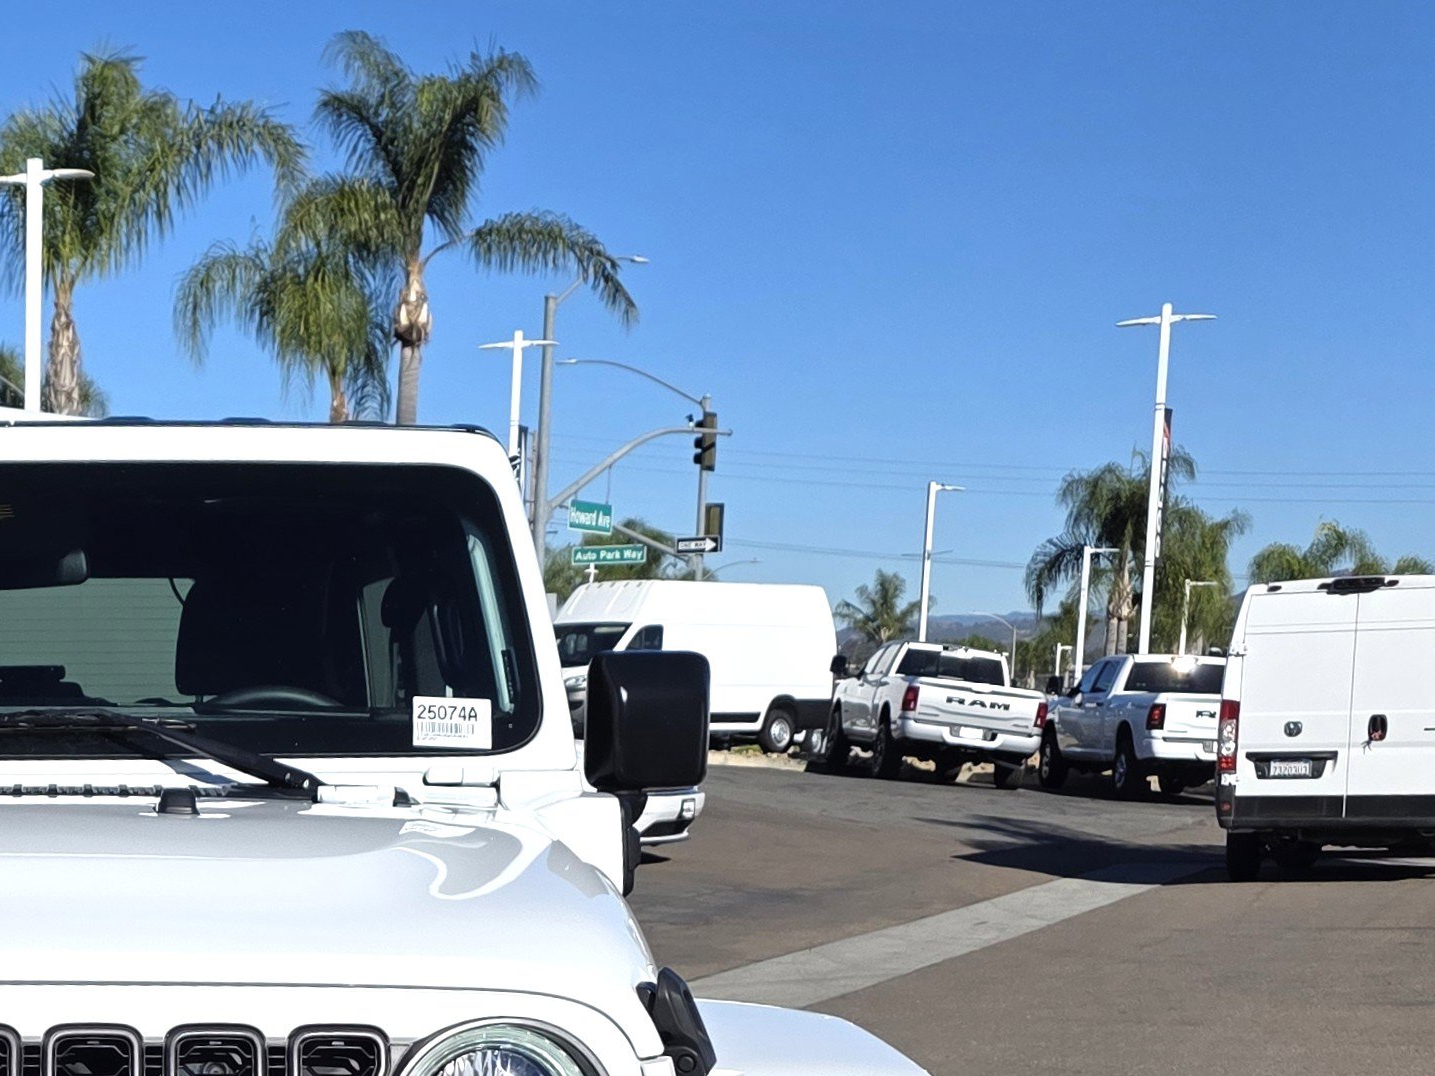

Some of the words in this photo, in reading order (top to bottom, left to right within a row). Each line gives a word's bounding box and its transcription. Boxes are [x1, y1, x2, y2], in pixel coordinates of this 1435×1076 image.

[570, 506, 597, 527] Howard
[597, 510, 611, 529] Ave
[575, 551, 597, 561] Auto
[600, 549, 621, 560] Park
[623, 549, 643, 561] Way
[946, 696, 1010, 711] RAM
[417, 704, 478, 722] 25074A
